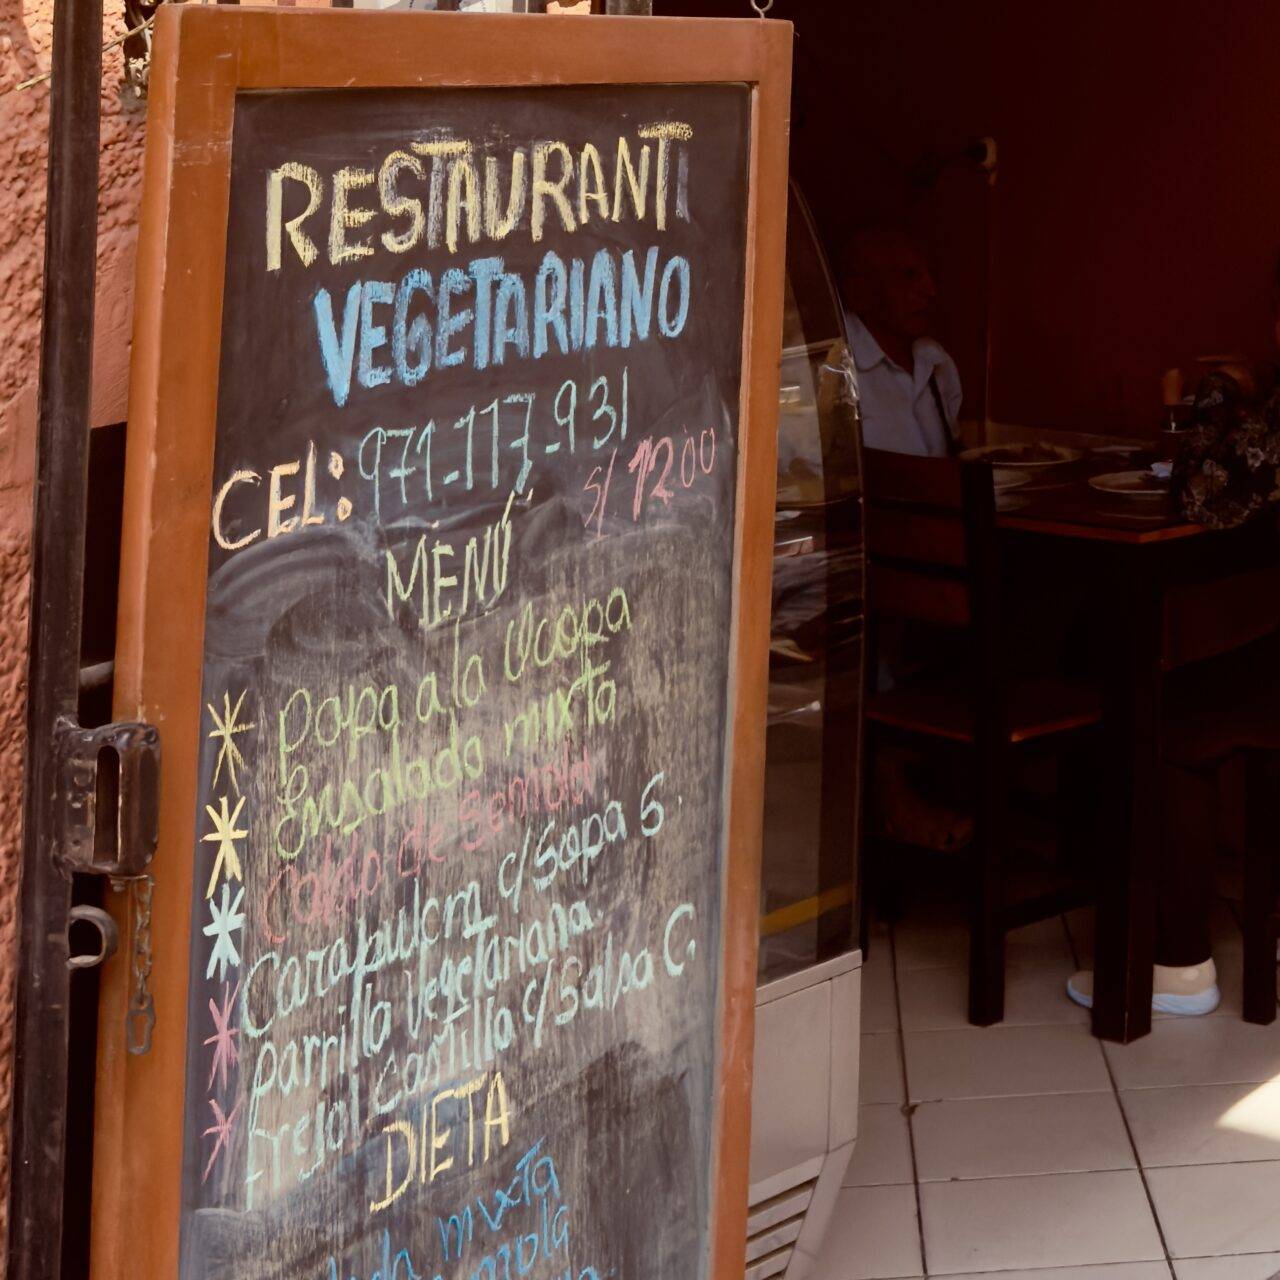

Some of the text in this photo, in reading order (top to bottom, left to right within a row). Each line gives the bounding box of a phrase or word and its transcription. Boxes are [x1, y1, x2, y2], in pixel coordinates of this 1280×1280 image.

[313, 246, 690, 408] VEGETARIANO
[211, 367, 629, 550] CEL: 971-117-931
[367, 1071, 512, 1214] DIETA
